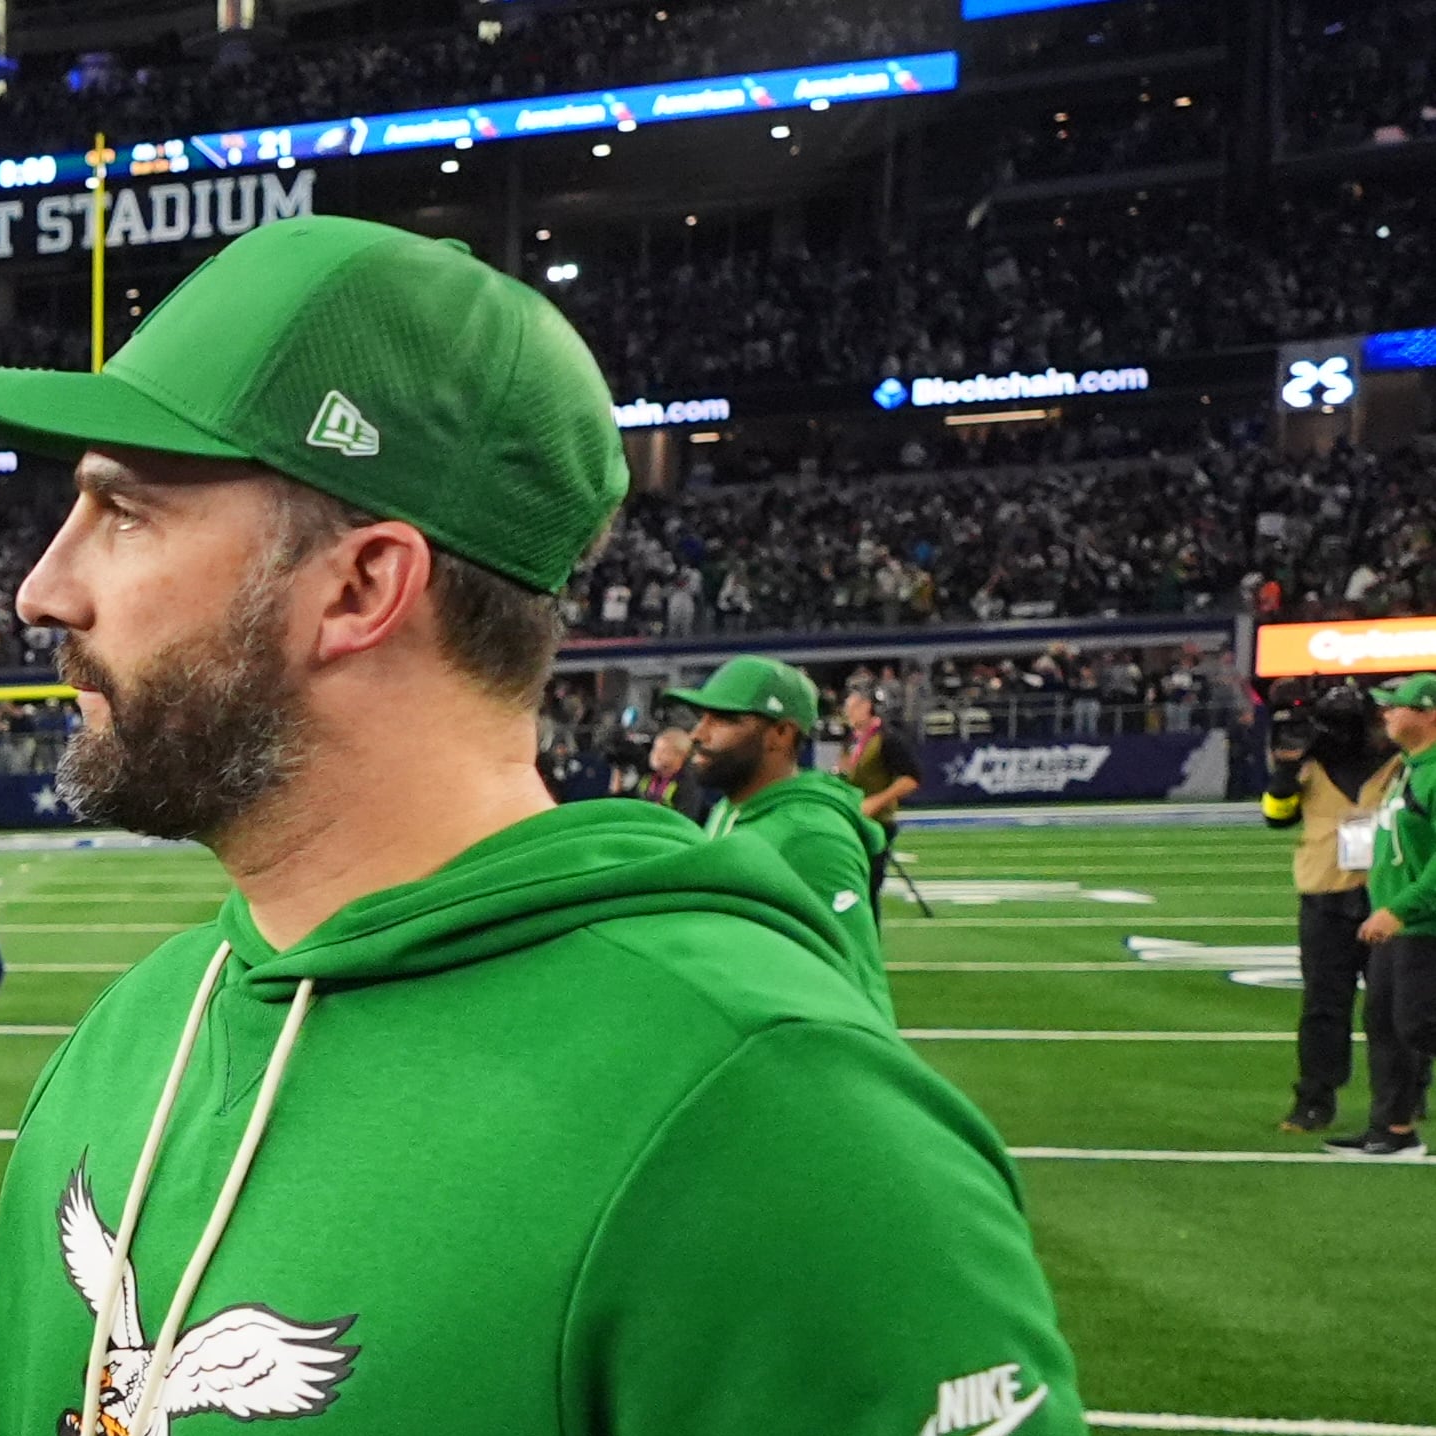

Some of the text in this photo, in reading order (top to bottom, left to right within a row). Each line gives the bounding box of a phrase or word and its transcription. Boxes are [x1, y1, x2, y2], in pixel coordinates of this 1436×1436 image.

[37, 169, 317, 254] STADIUM
[911, 367, 1149, 406] Blockchain.com
[937, 1363, 1021, 1434] NIKE
